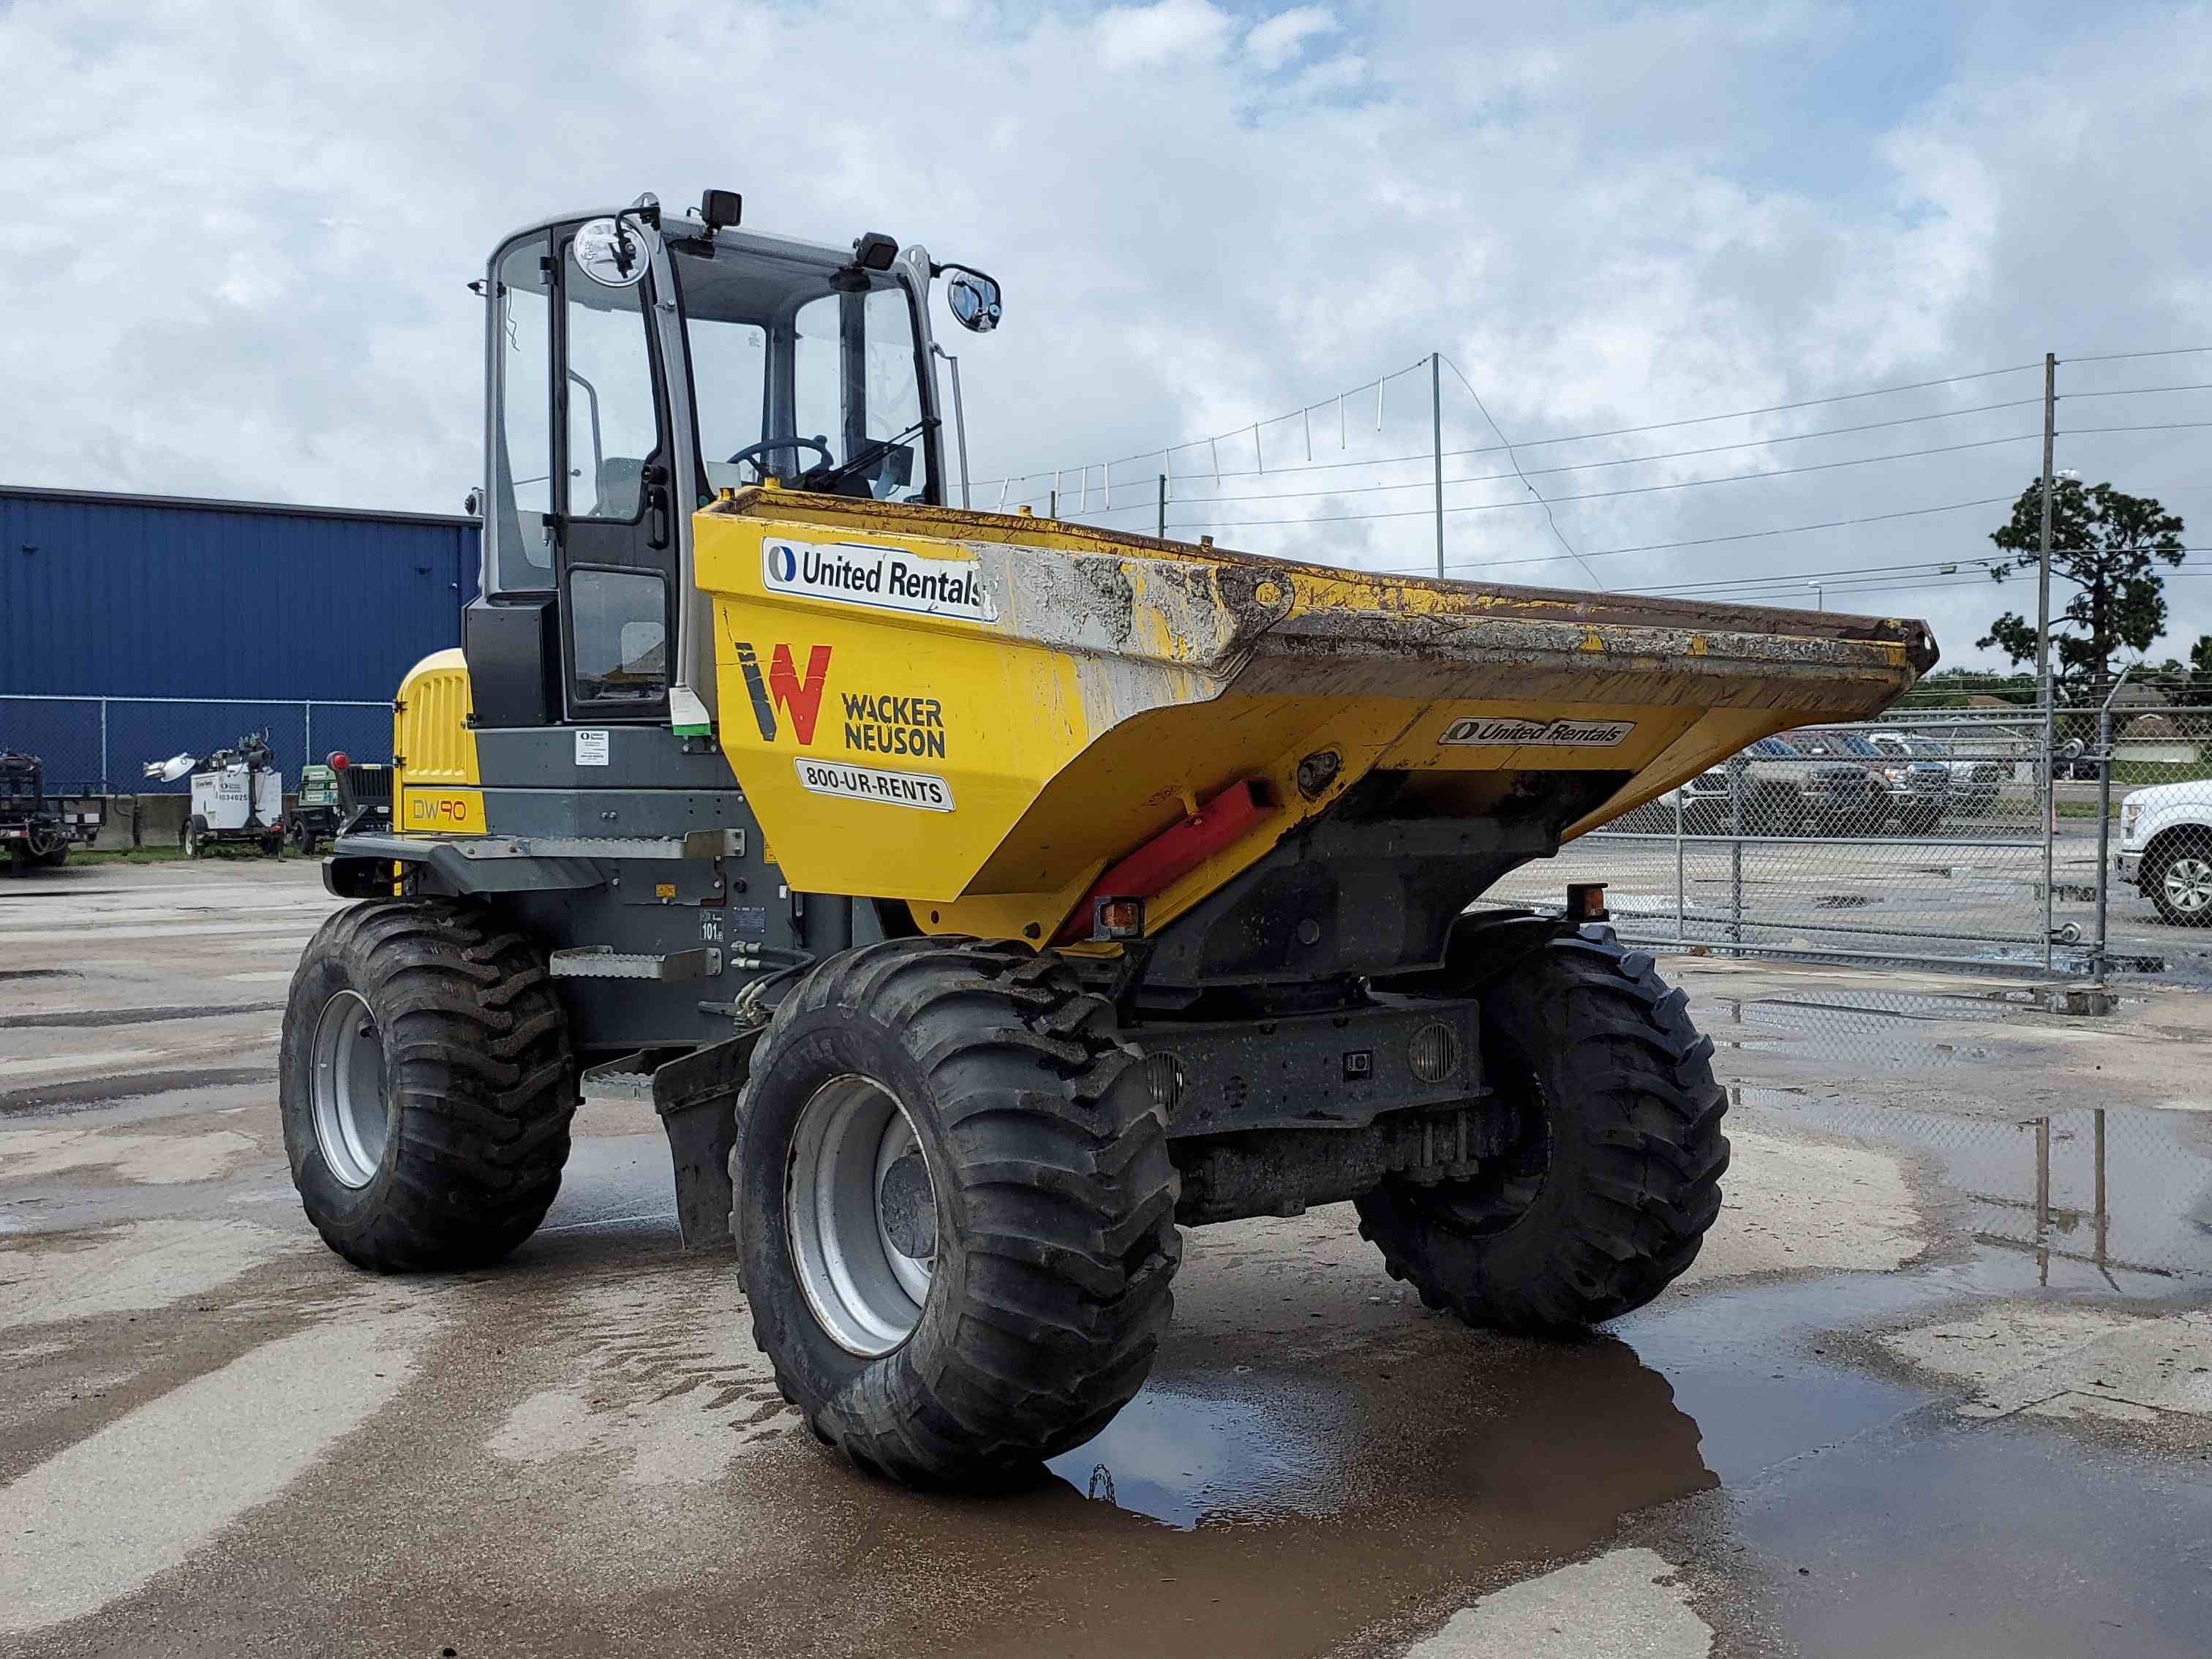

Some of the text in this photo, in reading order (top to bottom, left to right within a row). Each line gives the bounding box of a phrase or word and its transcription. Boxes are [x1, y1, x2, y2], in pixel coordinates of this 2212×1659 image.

[803, 552, 882, 592] United
[841, 692, 944, 728] WACKER
[844, 722, 945, 759] NEUSON
[1478, 723, 1621, 742] United Rentals
[806, 767, 943, 804] 800-UR-RENTS
[413, 800, 466, 820] DW90
[702, 922, 717, 940] 101
